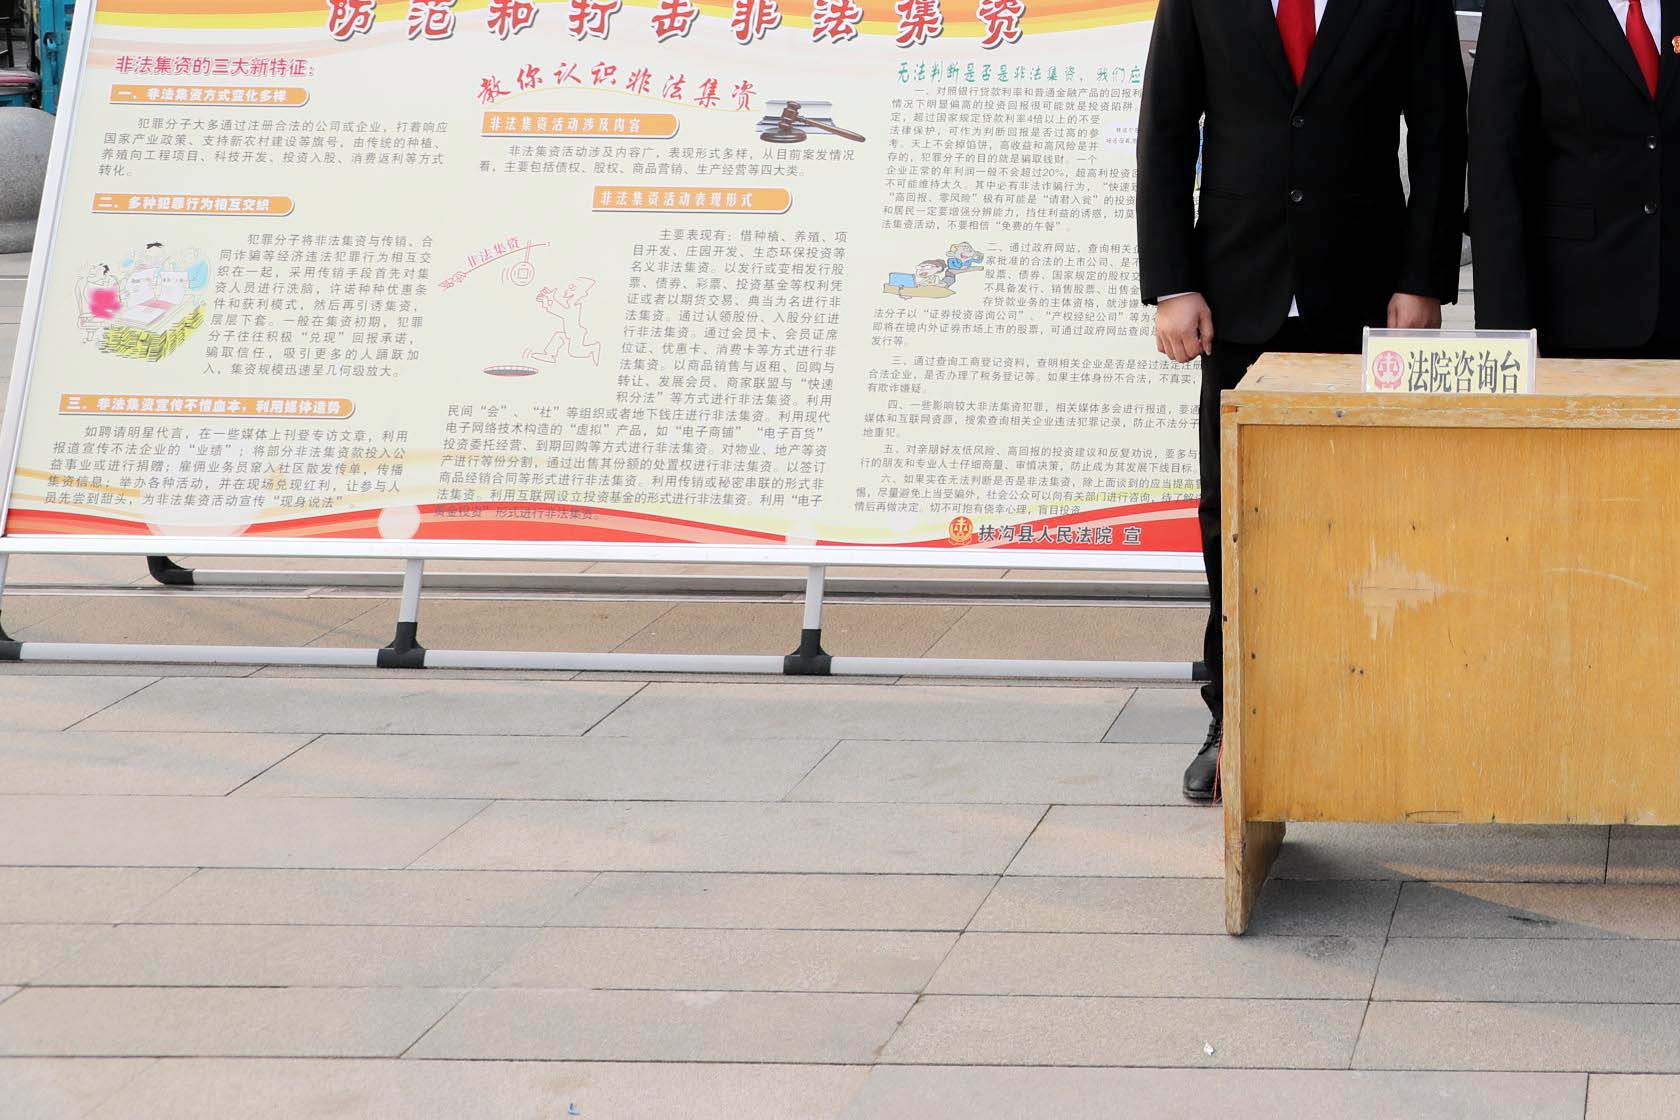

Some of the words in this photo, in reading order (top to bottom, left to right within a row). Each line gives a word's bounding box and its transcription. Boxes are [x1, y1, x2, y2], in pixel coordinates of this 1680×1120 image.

[115, 55, 314, 78] 非法集资的三大新特征：
[477, 62, 757, 111] 教你认识非法集资
[1407, 350, 1521, 393] 法院咨询台
[978, 524, 1113, 545] 扶沟县人民法院
[1122, 526, 1142, 545] 宣
